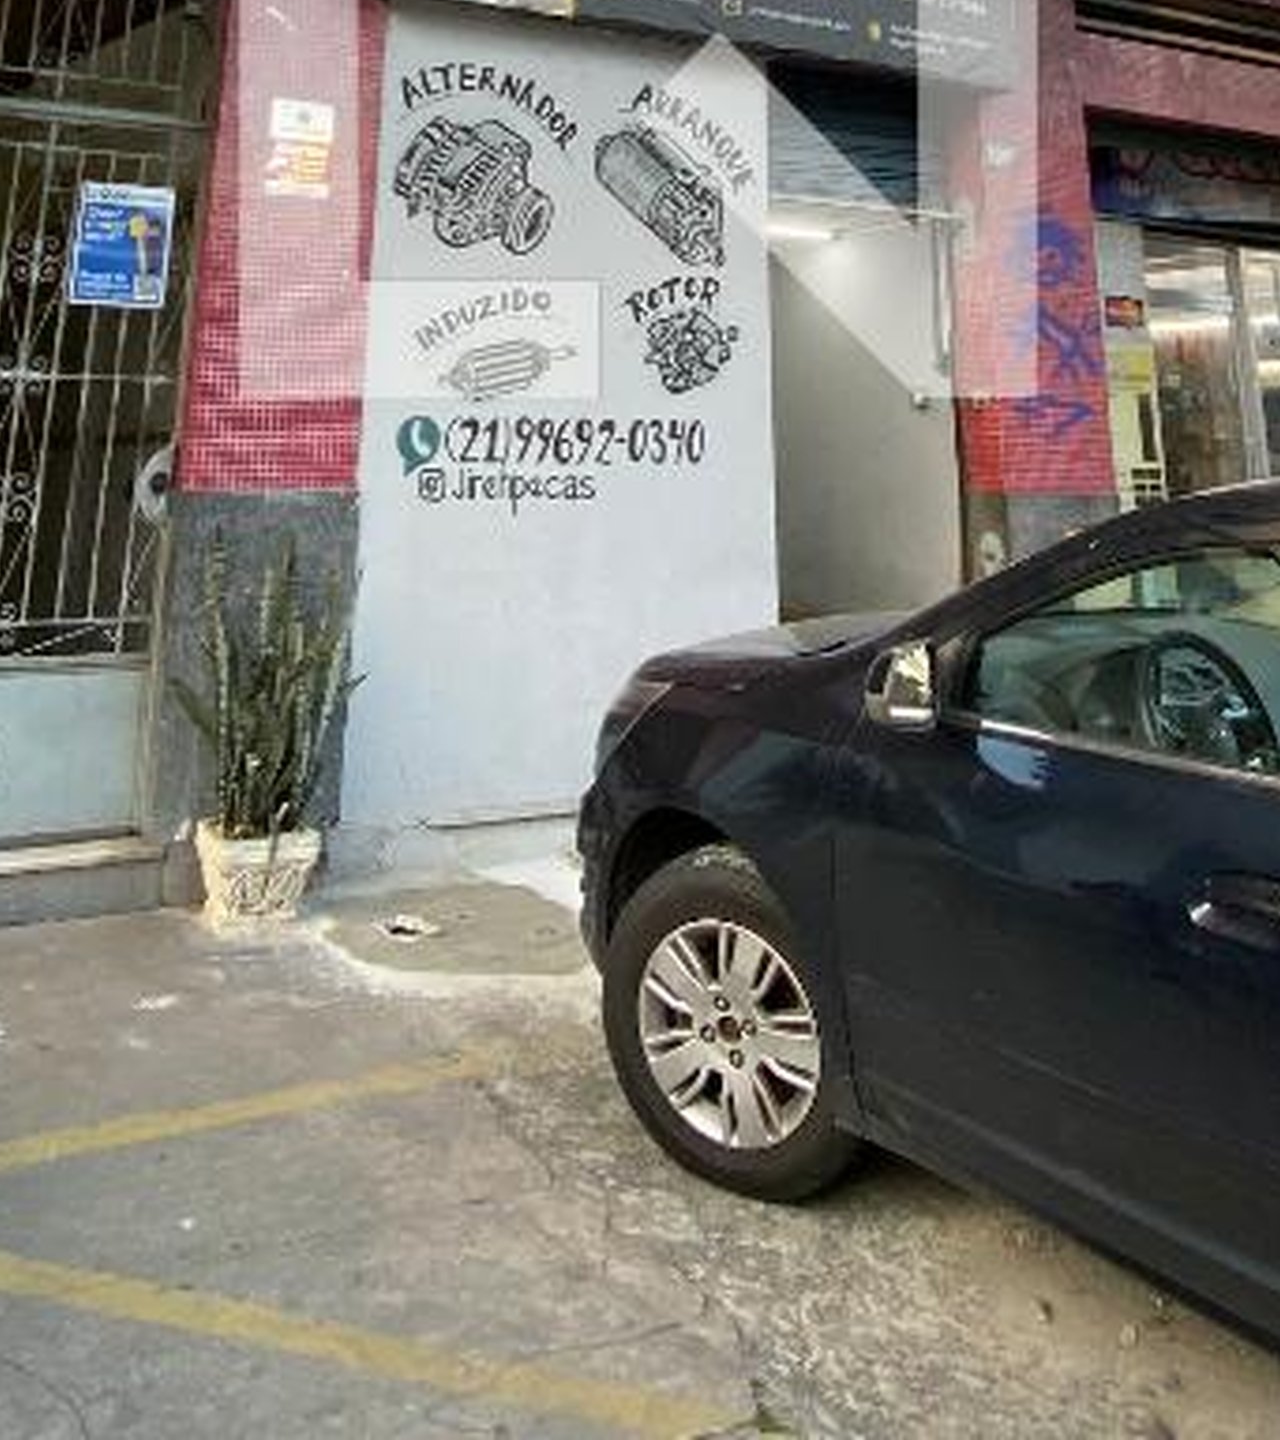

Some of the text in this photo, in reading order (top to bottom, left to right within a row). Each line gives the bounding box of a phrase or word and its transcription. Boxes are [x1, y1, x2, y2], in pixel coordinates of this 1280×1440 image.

[401, 62, 578, 152] ALTERNADOR
[632, 83, 758, 194] ARRANQUE
[413, 288, 552, 350] INDUZIDO
[625, 276, 721, 323] ROTOR
